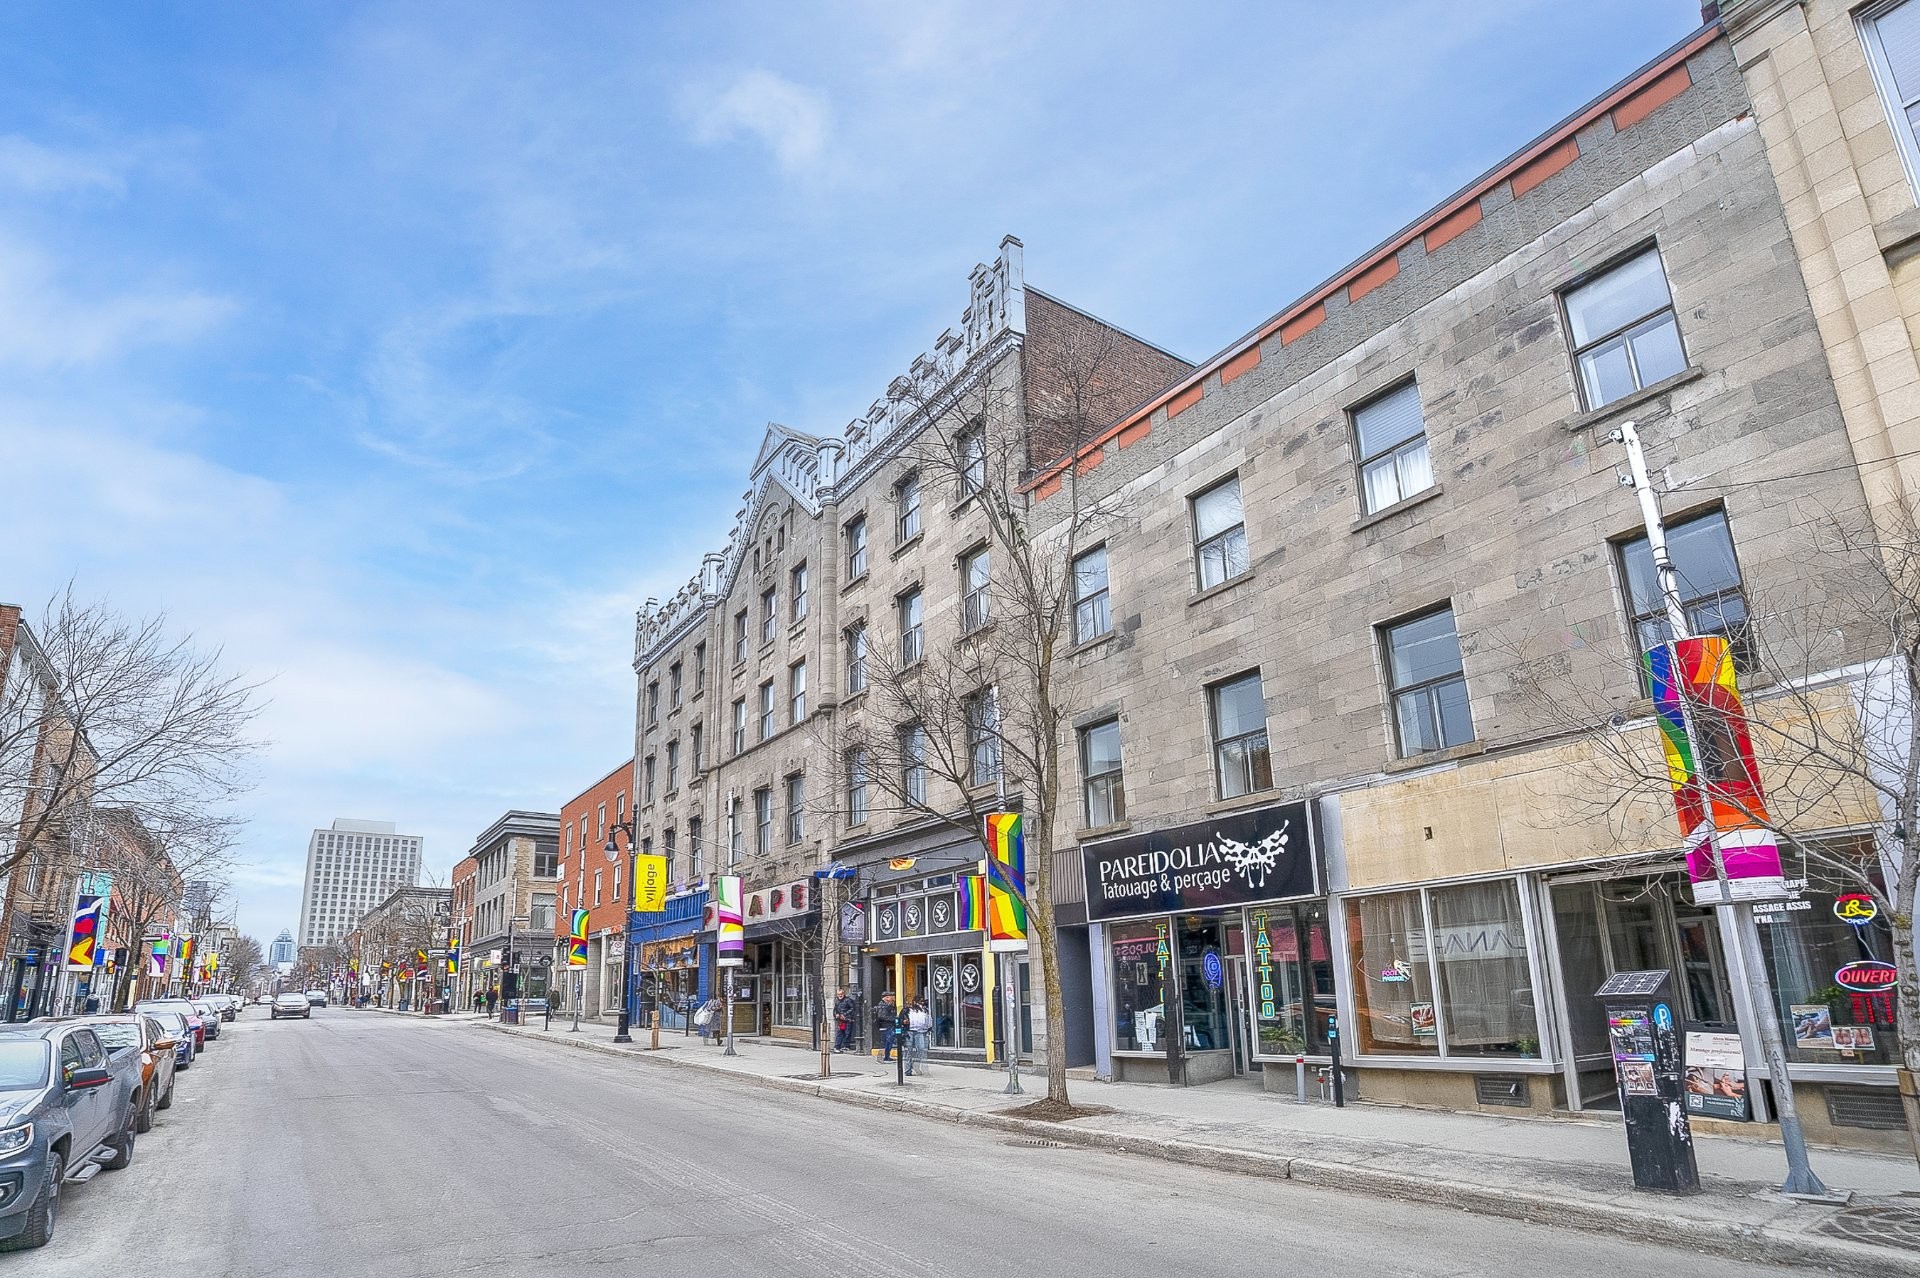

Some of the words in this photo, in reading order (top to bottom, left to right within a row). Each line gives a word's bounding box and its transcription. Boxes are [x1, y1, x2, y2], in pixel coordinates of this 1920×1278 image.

[1099, 841, 1221, 882] PAREIDOLIA
[644, 863, 658, 903] village
[1101, 879, 1158, 900] Tatouage
[1160, 872, 1172, 892] &
[1173, 868, 1231, 895] perçage
[1785, 900, 1812, 911] ASSIS
[1254, 913, 1275, 1019] TATTOO
[1839, 969, 1896, 983] OUVERT
